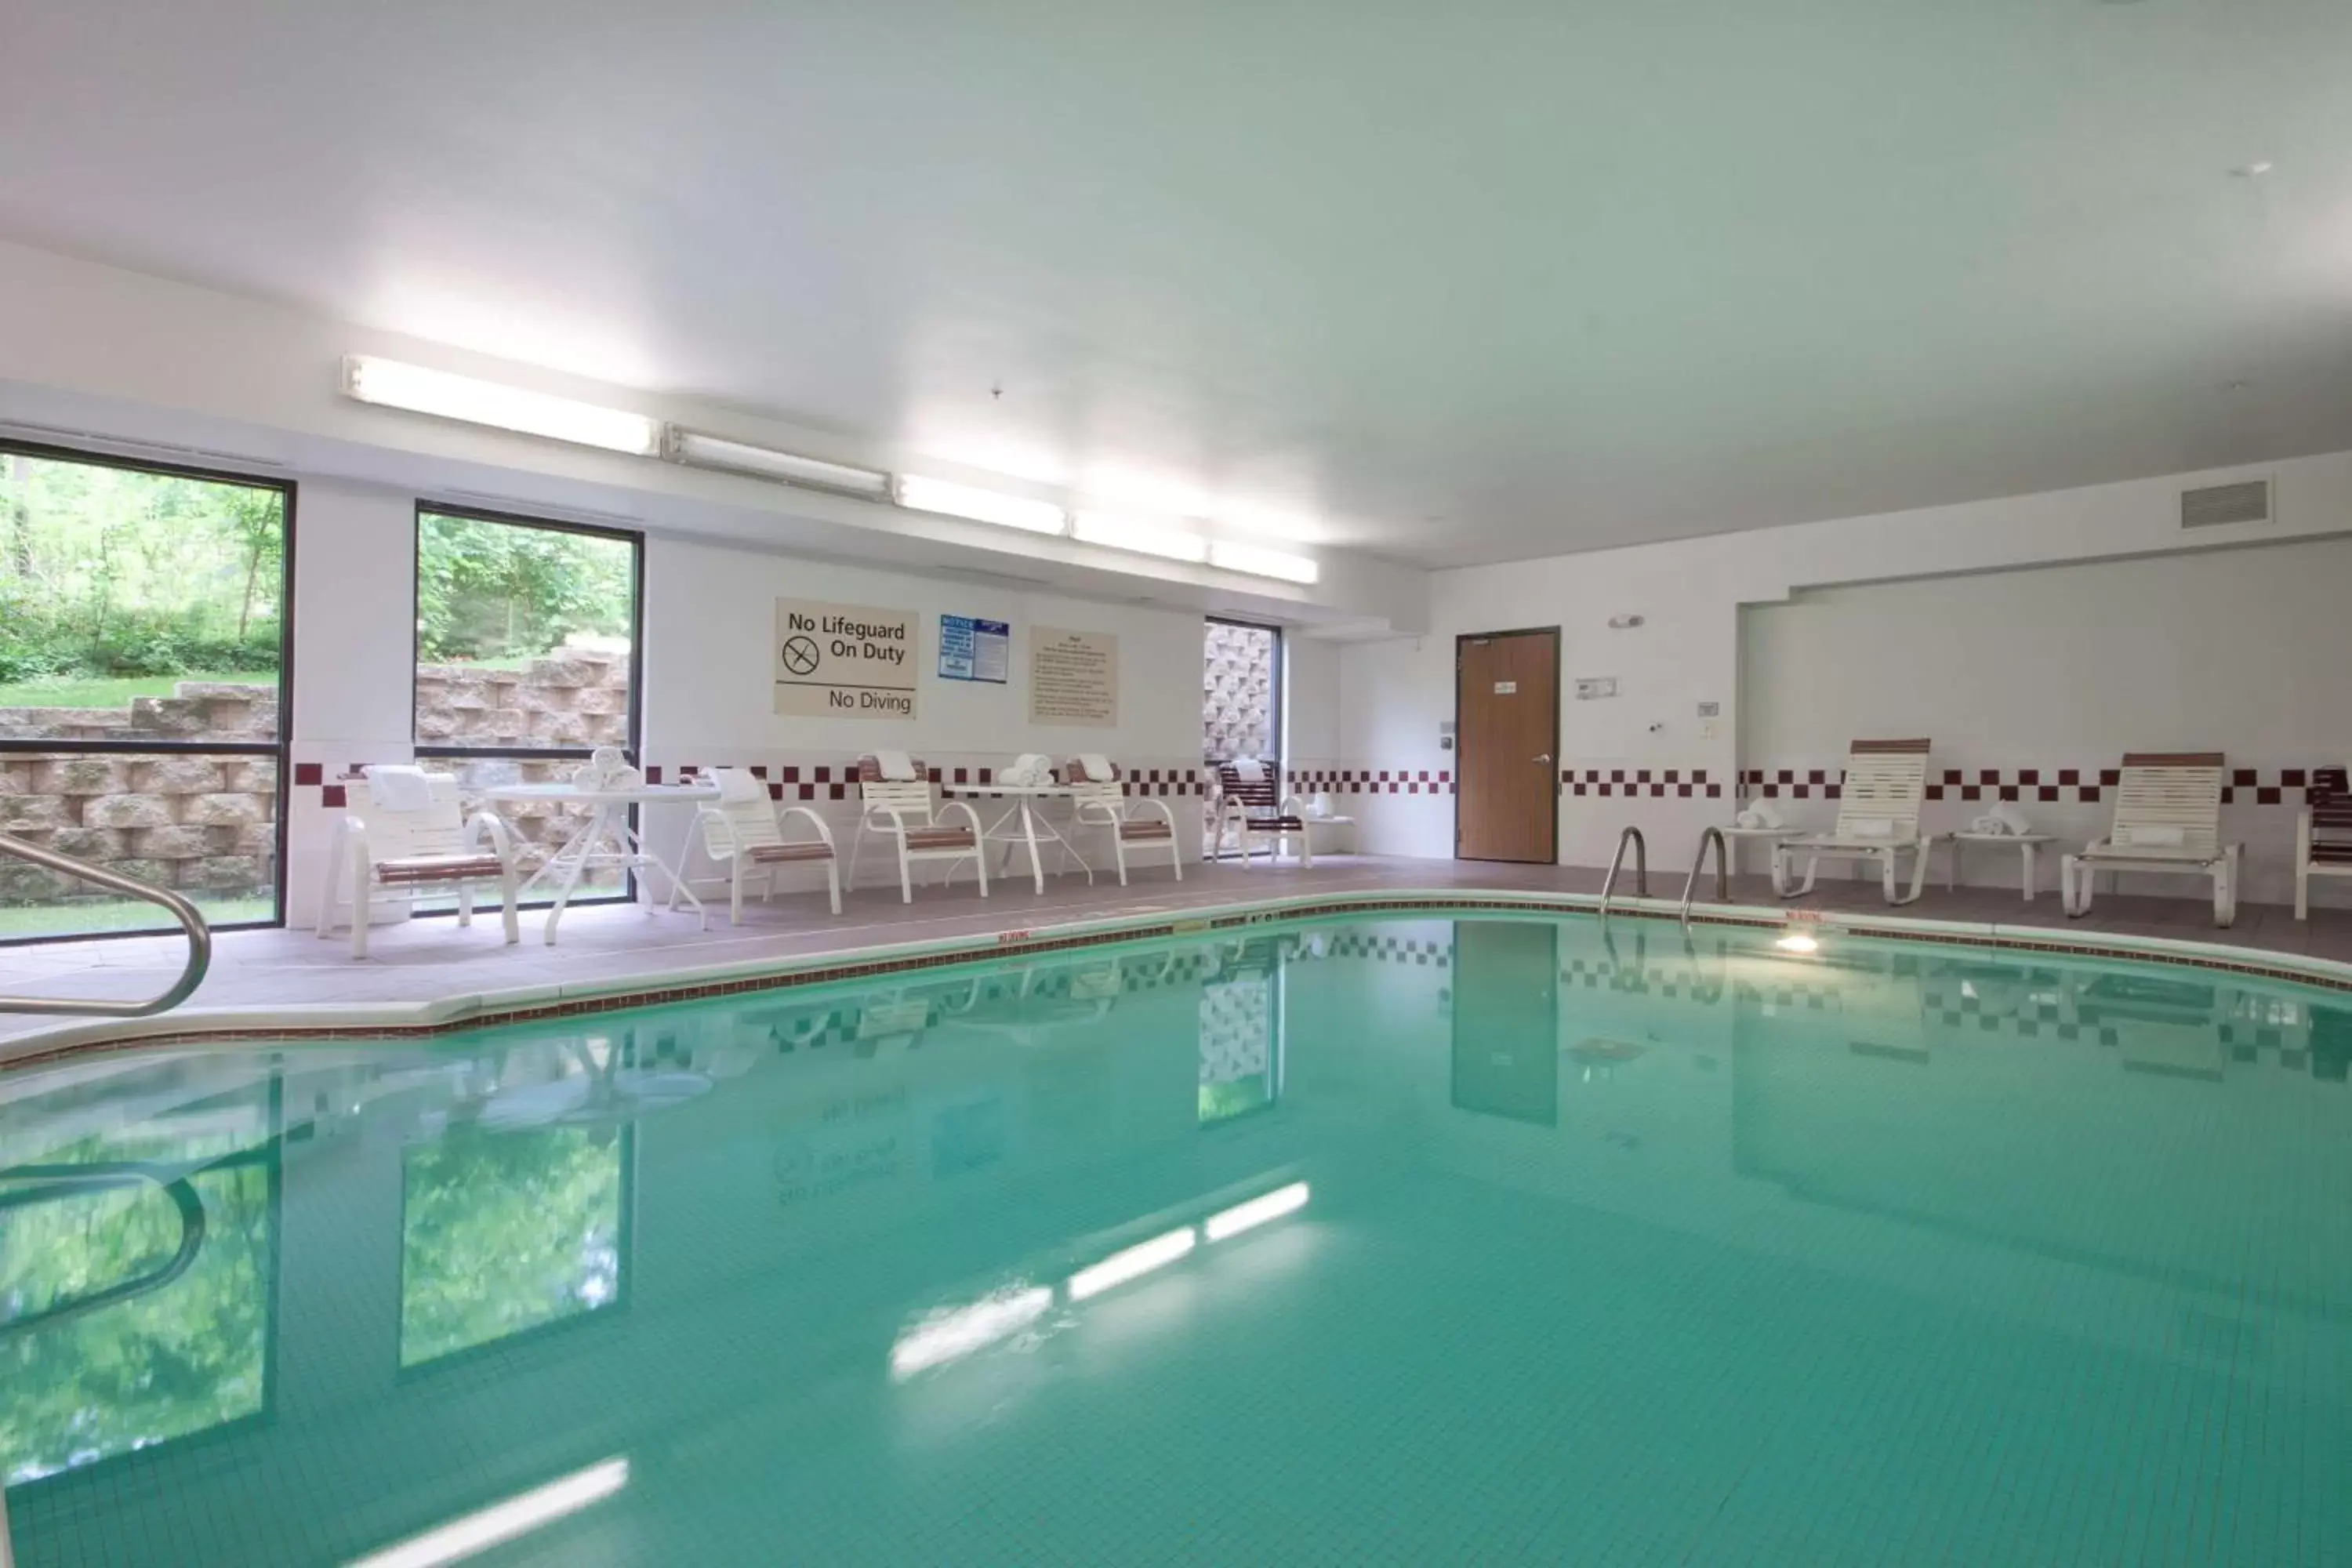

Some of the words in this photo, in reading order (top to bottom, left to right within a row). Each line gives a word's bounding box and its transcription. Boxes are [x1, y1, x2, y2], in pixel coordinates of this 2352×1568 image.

[789, 613, 816, 632] No
[822, 615, 905, 641] Lifeguard
[831, 640, 857, 658] On
[863, 642, 905, 666] Duty
[830, 690, 855, 707] No
[861, 691, 911, 714] Diving
